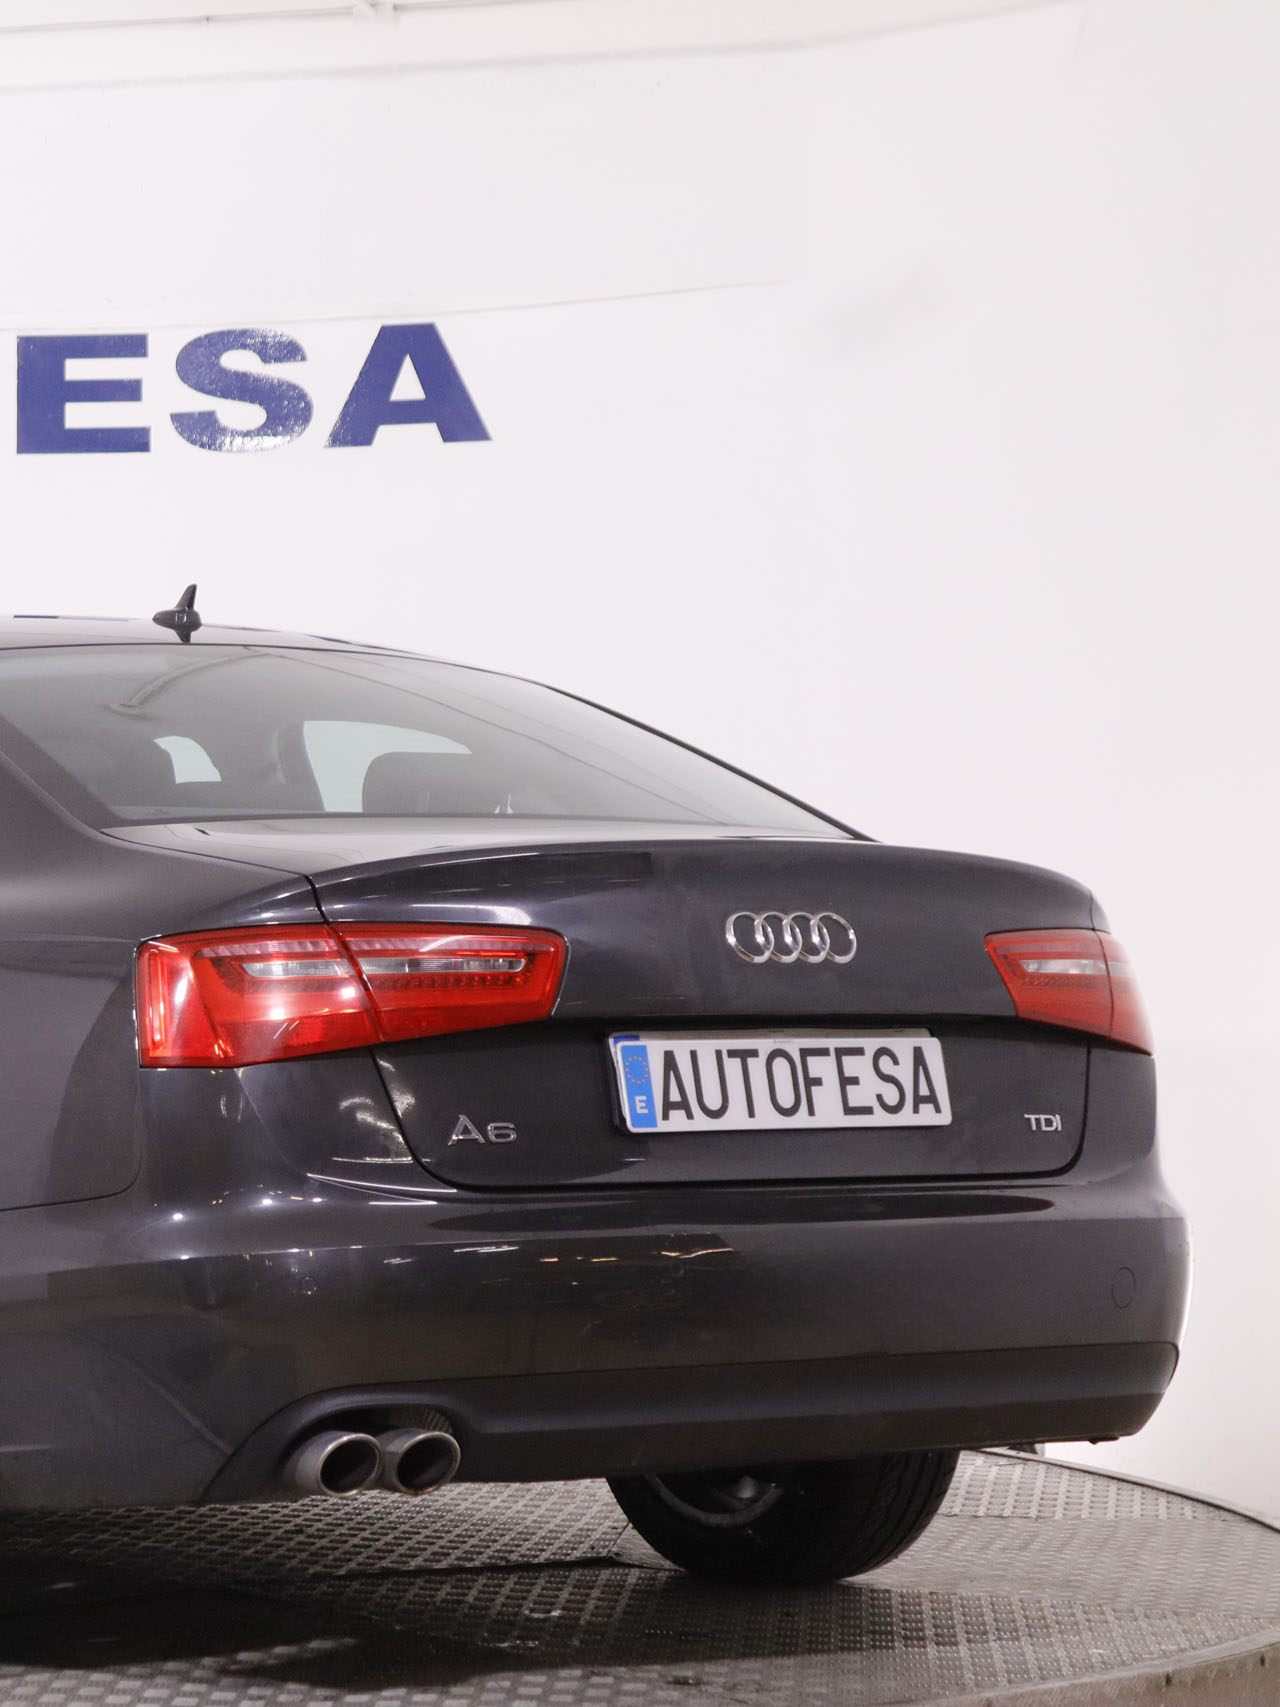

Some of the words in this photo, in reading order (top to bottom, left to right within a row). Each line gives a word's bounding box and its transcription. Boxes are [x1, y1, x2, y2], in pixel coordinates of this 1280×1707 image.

[634, 1095, 649, 1114] E
[662, 1046, 942, 1121] AUTOFESA
[447, 1114, 517, 1145] A6
[1023, 1113, 1062, 1131] TDI
